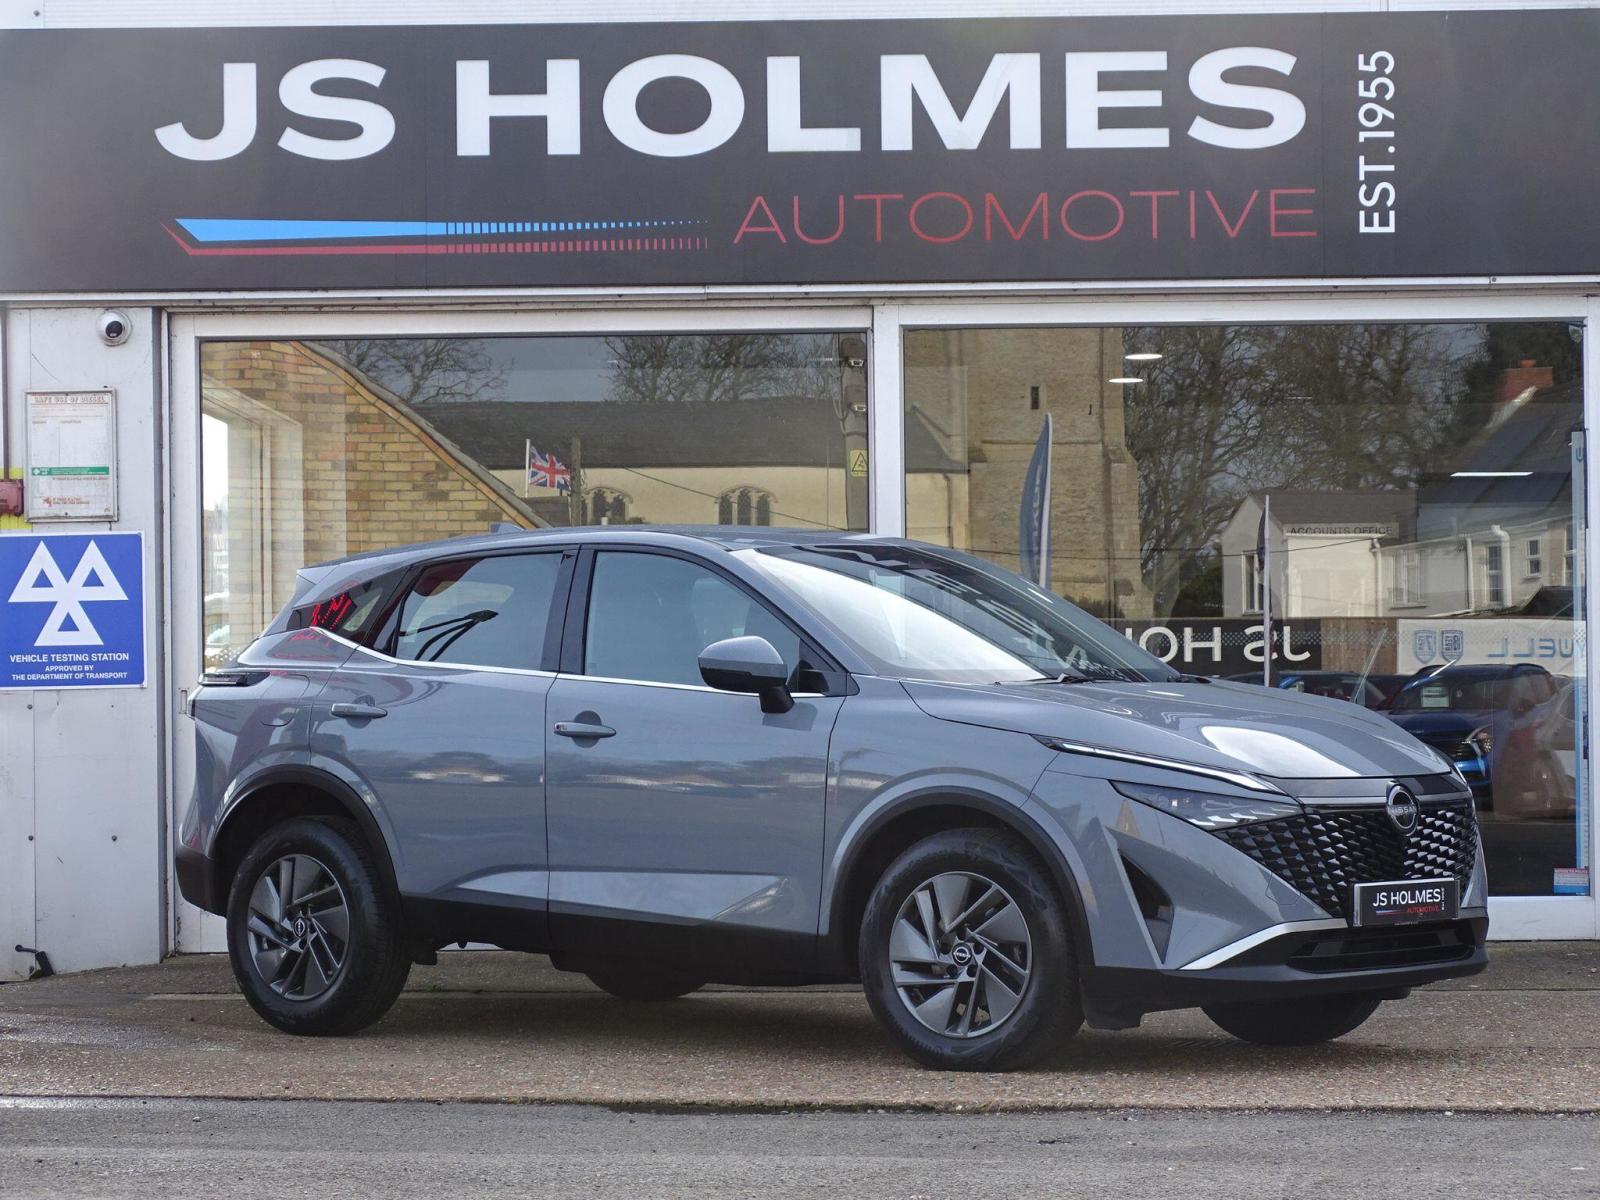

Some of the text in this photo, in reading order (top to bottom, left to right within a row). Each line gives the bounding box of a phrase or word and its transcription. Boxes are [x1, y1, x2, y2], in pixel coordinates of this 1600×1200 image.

[154, 46, 1307, 162] JS HOLMES
[1358, 49, 1396, 234] EST.1955
[732, 188, 1318, 245] AUTOMOTIVE
[10, 652, 129, 663] VEHICLE TESTING STATION
[1372, 892, 1388, 907] JS
[1390, 888, 1441, 905] HOLMES
